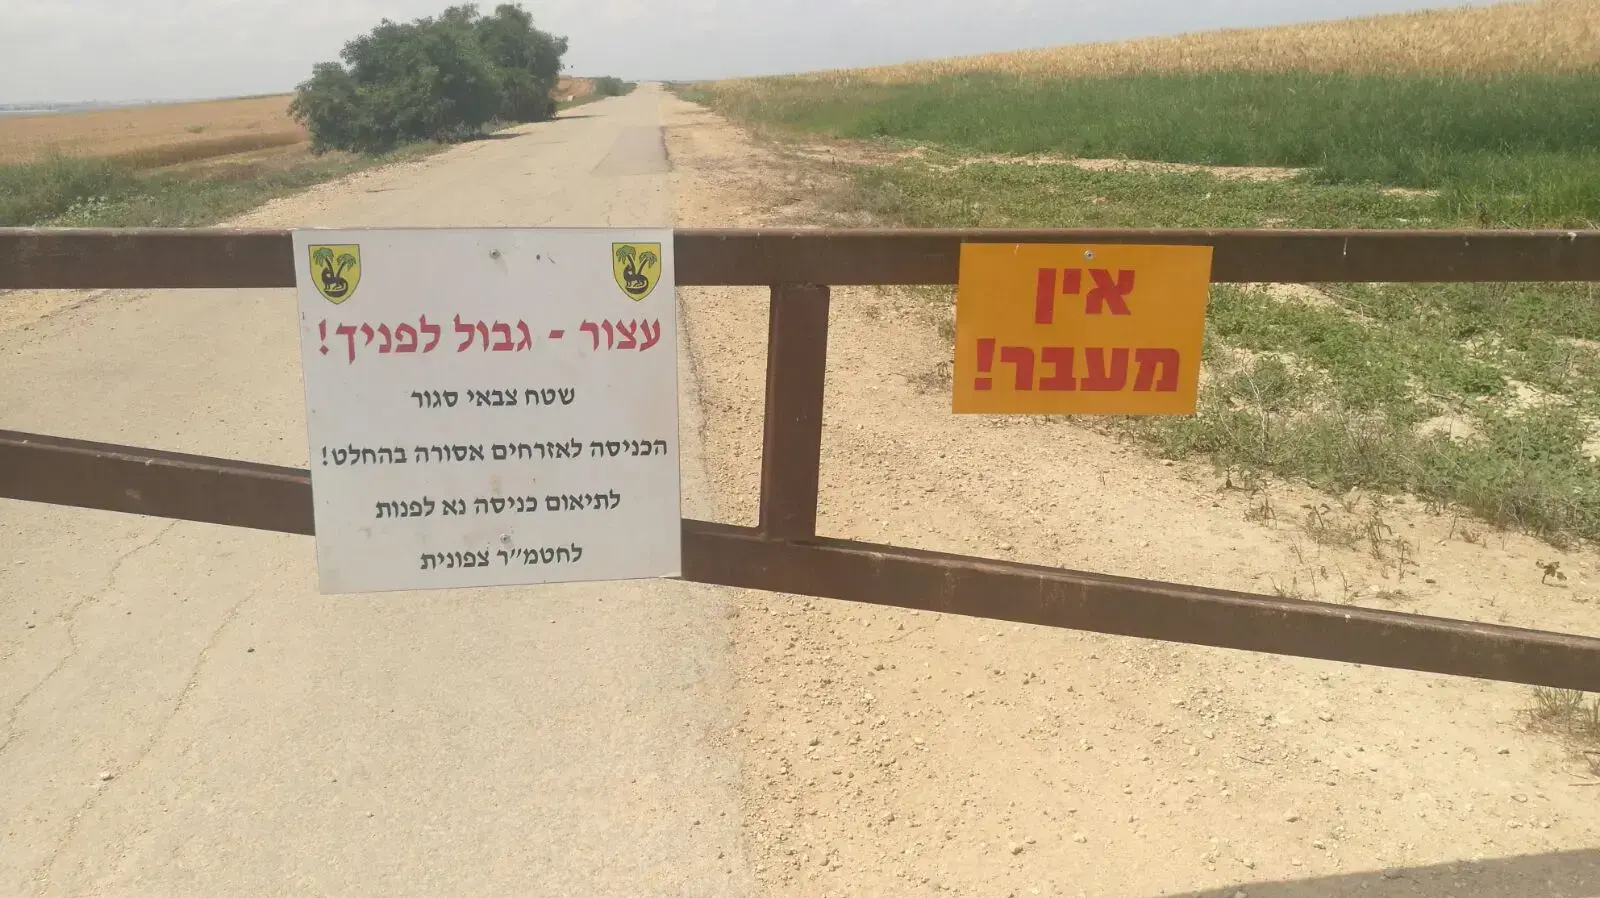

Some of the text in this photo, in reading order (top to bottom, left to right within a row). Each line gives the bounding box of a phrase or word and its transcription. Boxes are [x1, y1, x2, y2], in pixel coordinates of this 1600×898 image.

[1035, 268, 1135, 325] אין
[318, 313, 441, 365] לפניך!
[453, 313, 532, 353] גבול
[580, 318, 661, 352] עצור
[974, 338, 1180, 392] מעבר!
[411, 387, 575, 408] שטח צבאי סגור
[322, 438, 667, 466] הכניסה לאזרחים אסורה בהחלט!
[376, 489, 621, 518] לתיאום כניסה נא לפנות
[420, 549, 489, 570] צפונית
